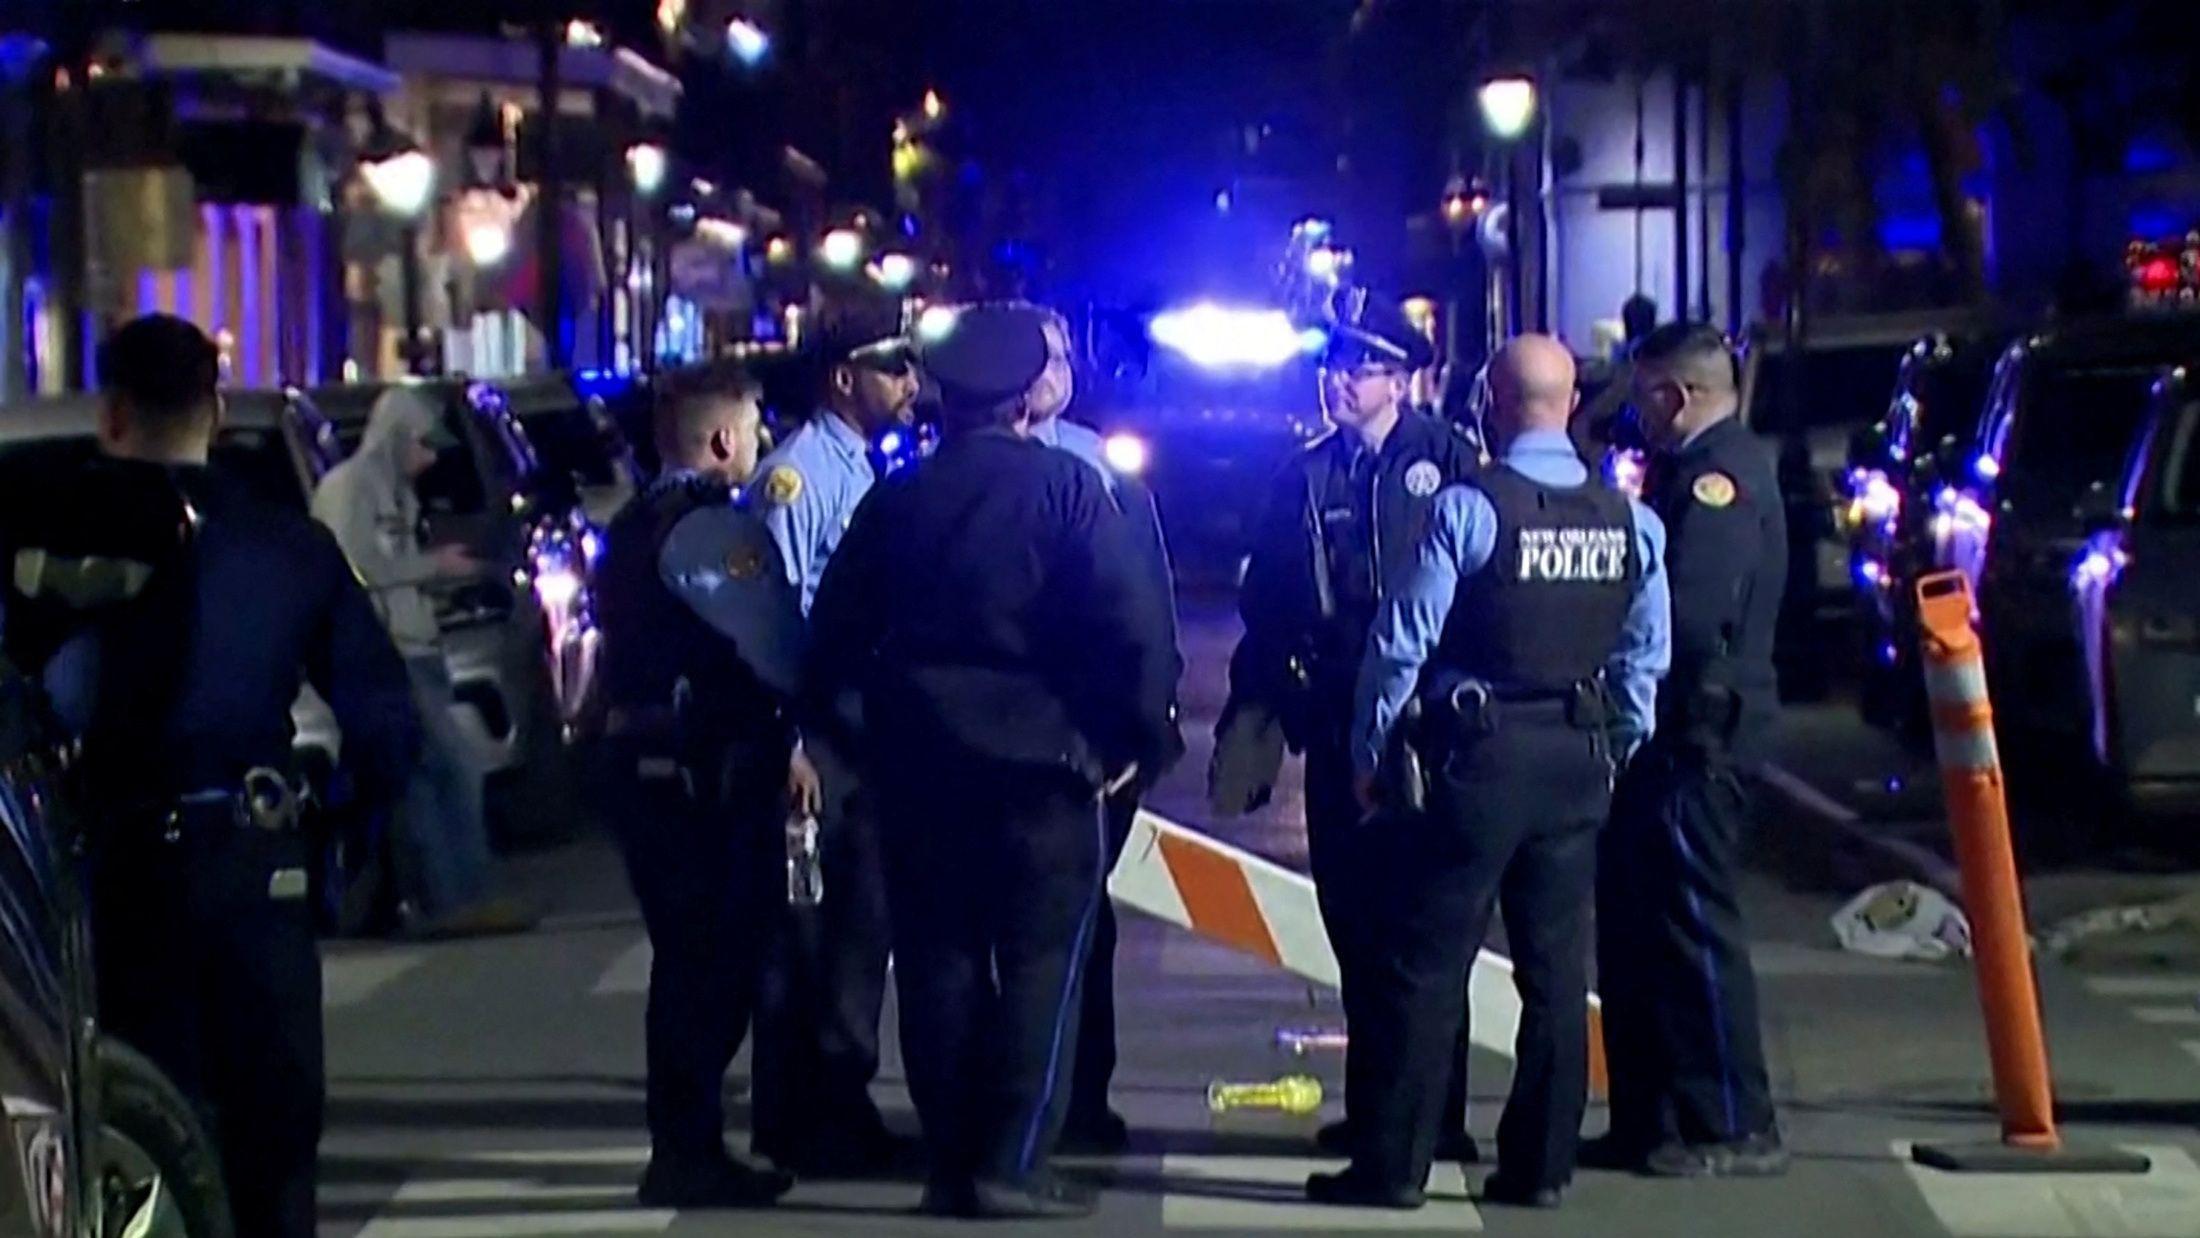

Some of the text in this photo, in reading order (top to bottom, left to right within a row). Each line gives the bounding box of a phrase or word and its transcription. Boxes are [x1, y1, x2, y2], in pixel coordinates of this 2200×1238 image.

[1520, 528, 1626, 545] NEW ORLEANS
[1519, 545, 1626, 580] POLICE
